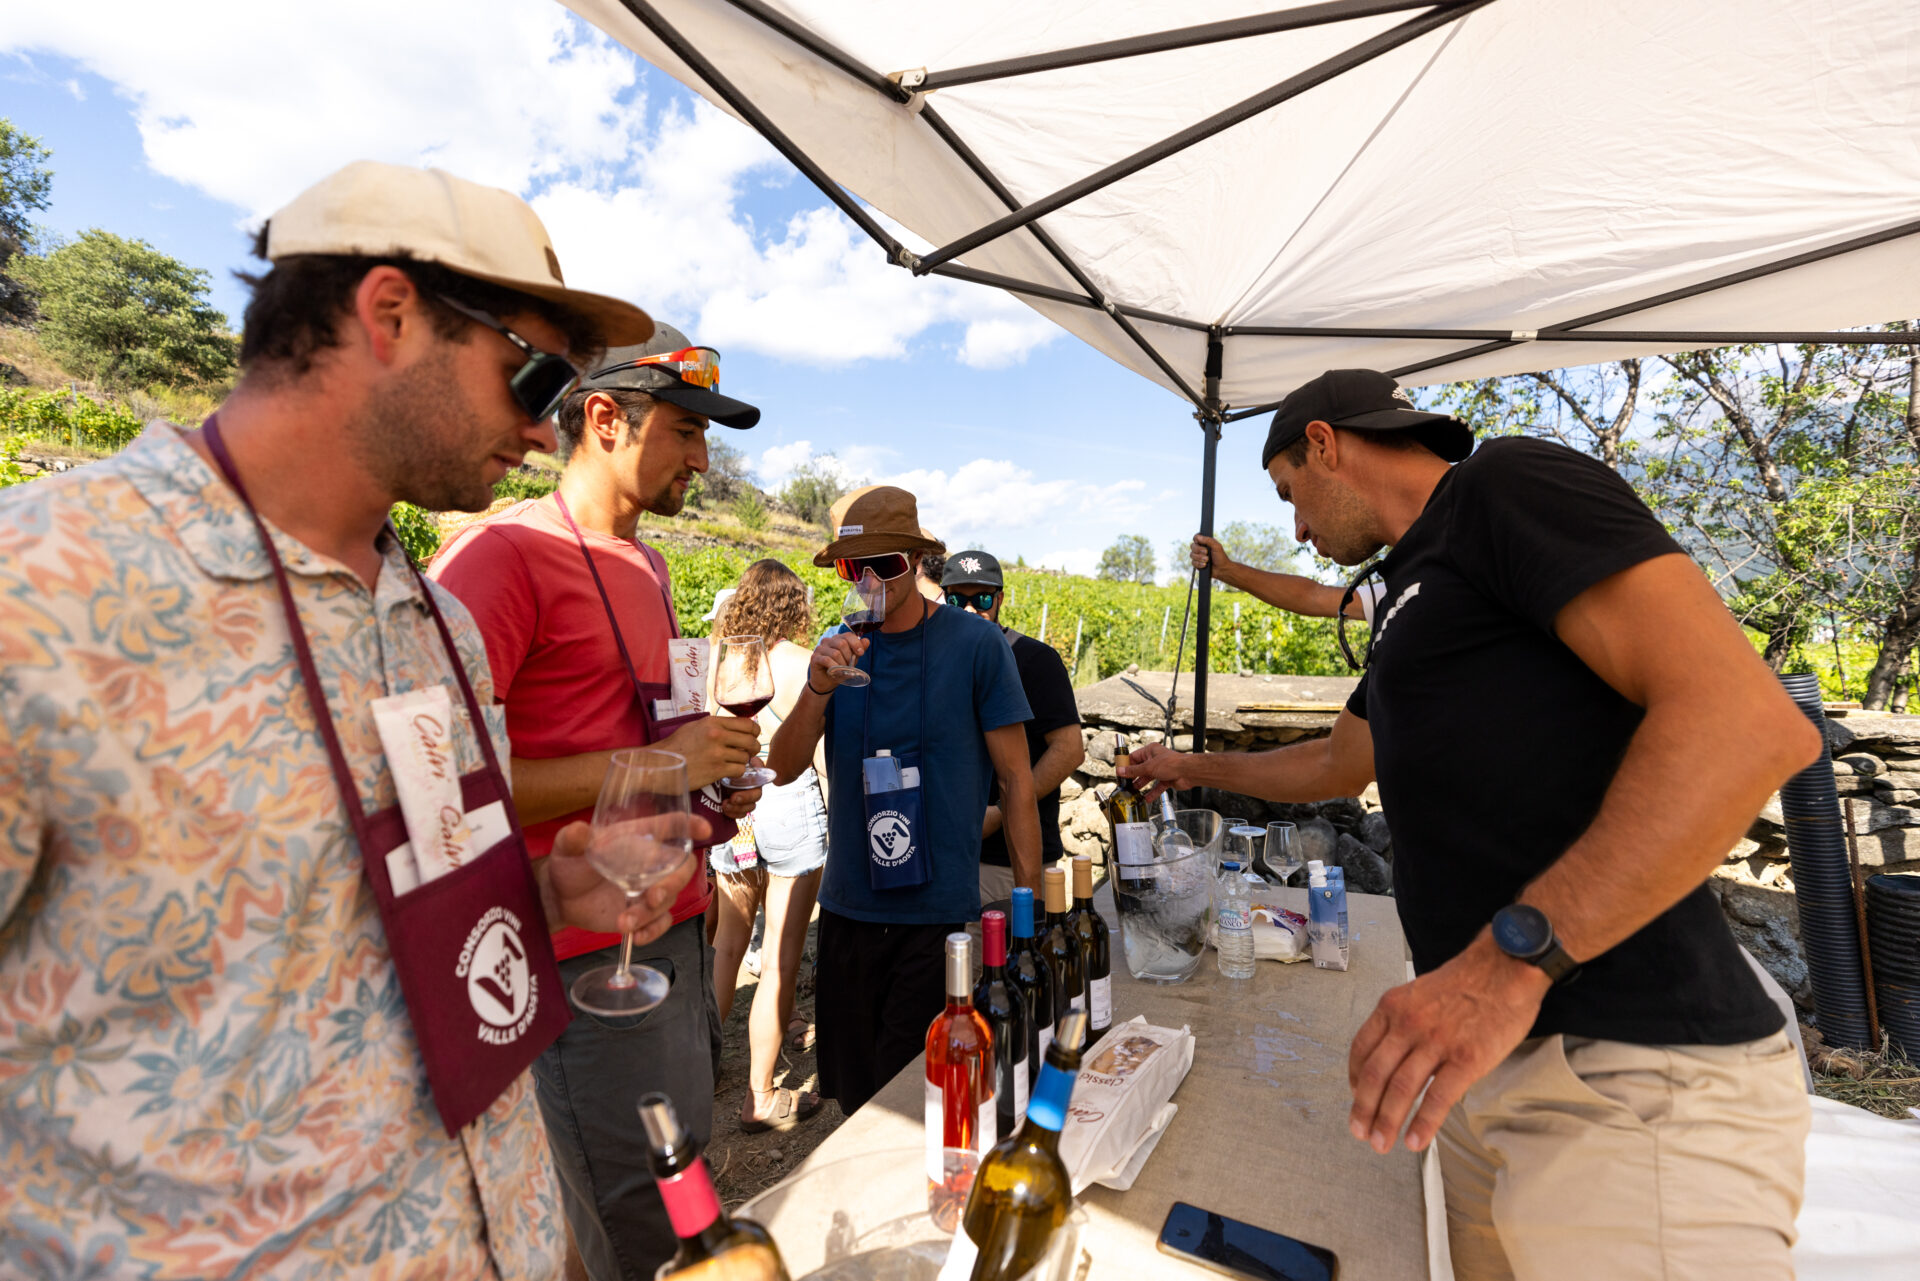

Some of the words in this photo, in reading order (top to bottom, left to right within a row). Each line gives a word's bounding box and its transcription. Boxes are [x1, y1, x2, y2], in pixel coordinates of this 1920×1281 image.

[688, 690, 702, 714] alvi
[867, 810, 898, 831] CONSORZIO
[899, 813, 911, 826] VINI
[871, 853, 891, 867] VALLE
[892, 846, 916, 867] D'AOSTA
[455, 906, 503, 978] CONSORZIO
[503, 908, 522, 933] VINI
[477, 1023, 517, 1045] VALLE
[517, 973, 539, 1036] D'AOSTA
